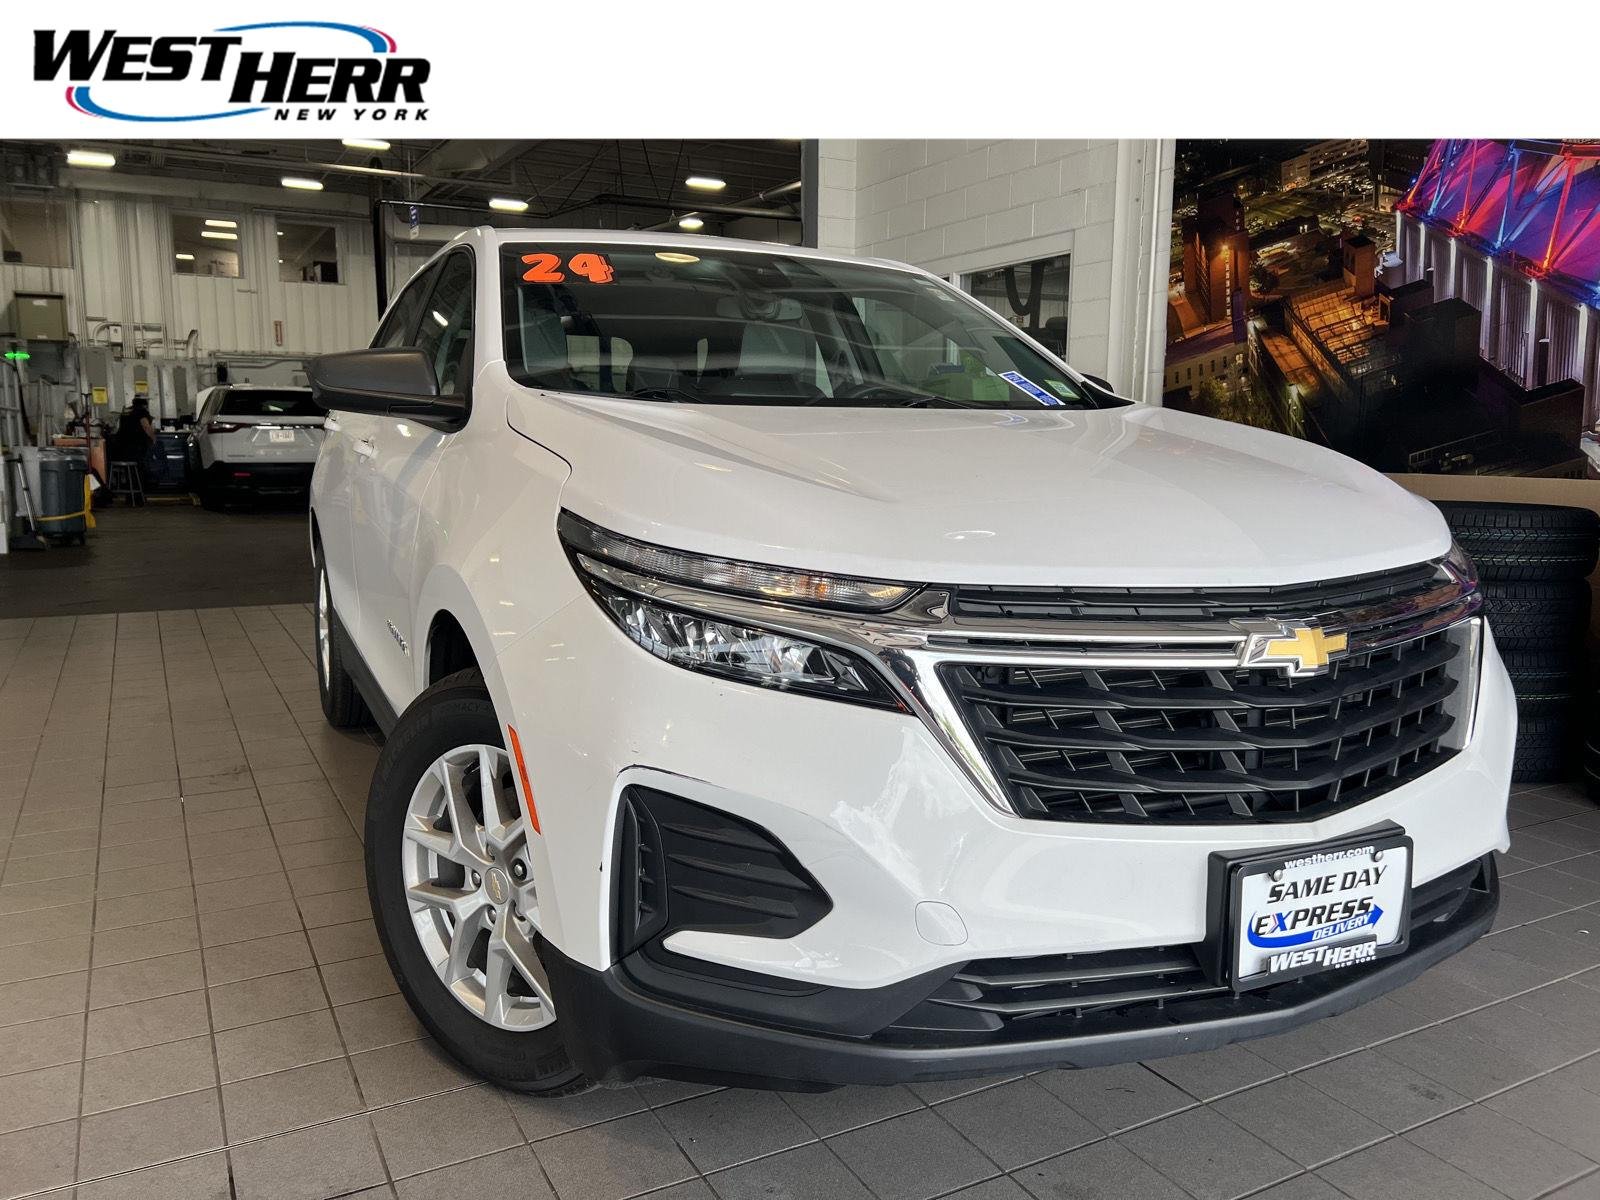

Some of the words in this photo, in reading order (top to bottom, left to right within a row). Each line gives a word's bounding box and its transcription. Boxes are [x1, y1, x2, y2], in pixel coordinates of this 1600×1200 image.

[521, 253, 615, 284] 24
[1284, 845, 1375, 869] westherr.com
[1267, 874, 1337, 904] SAME
[1340, 865, 1387, 892] DAY
[1253, 896, 1374, 936] EXPRESS
[1311, 913, 1372, 941] DELIVERY
[1269, 946, 1329, 973] WEST
[1322, 941, 1377, 967] HERR
